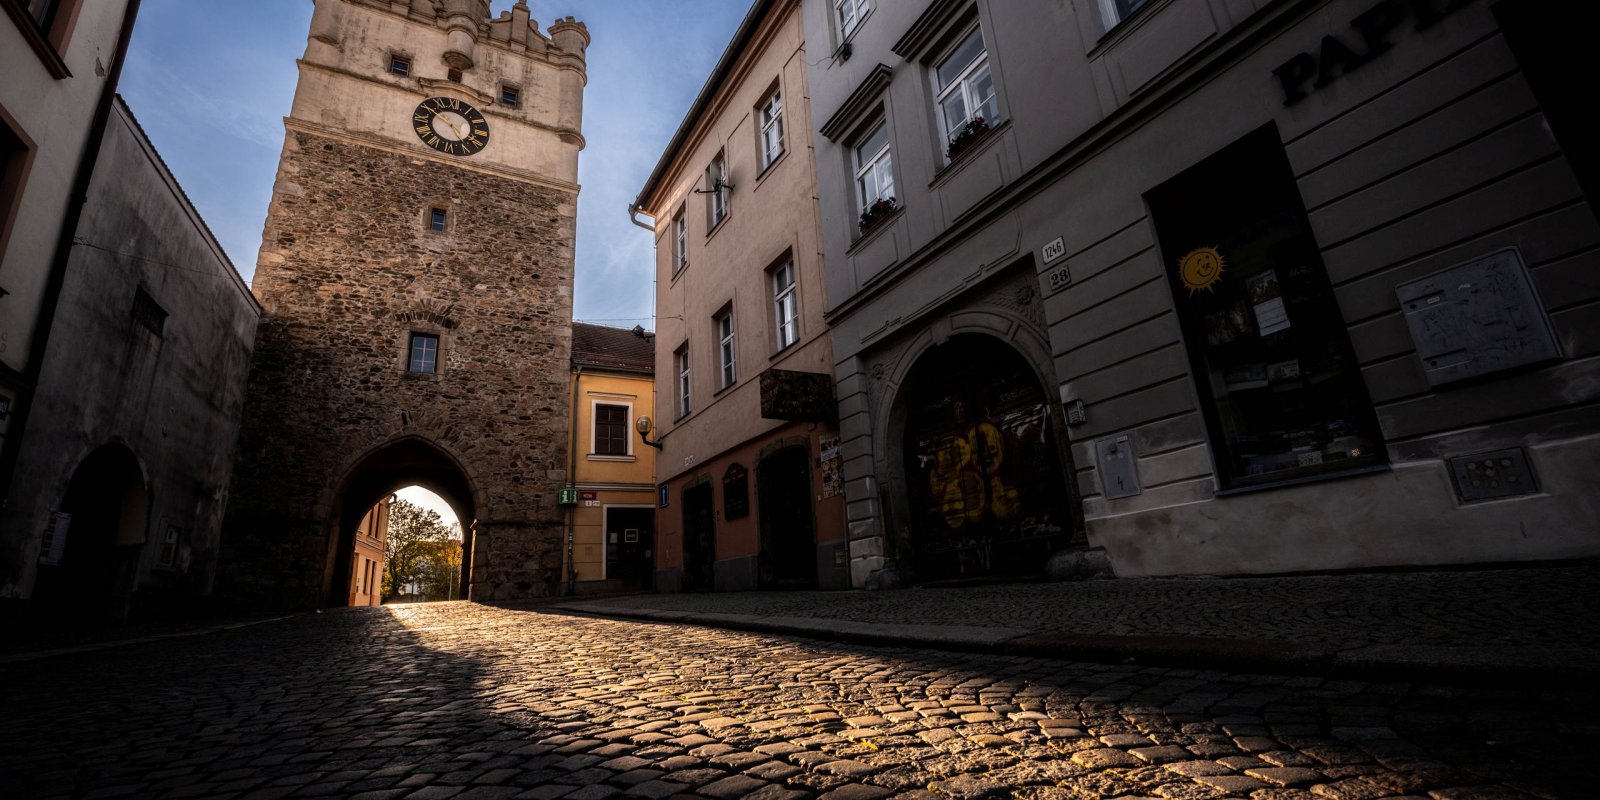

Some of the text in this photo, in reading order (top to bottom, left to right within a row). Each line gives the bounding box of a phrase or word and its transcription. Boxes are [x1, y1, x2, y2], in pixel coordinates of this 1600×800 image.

[448, 99, 460, 110] XII
[1045, 241, 1062, 259] 1246
[1051, 269, 1069, 286] 28
